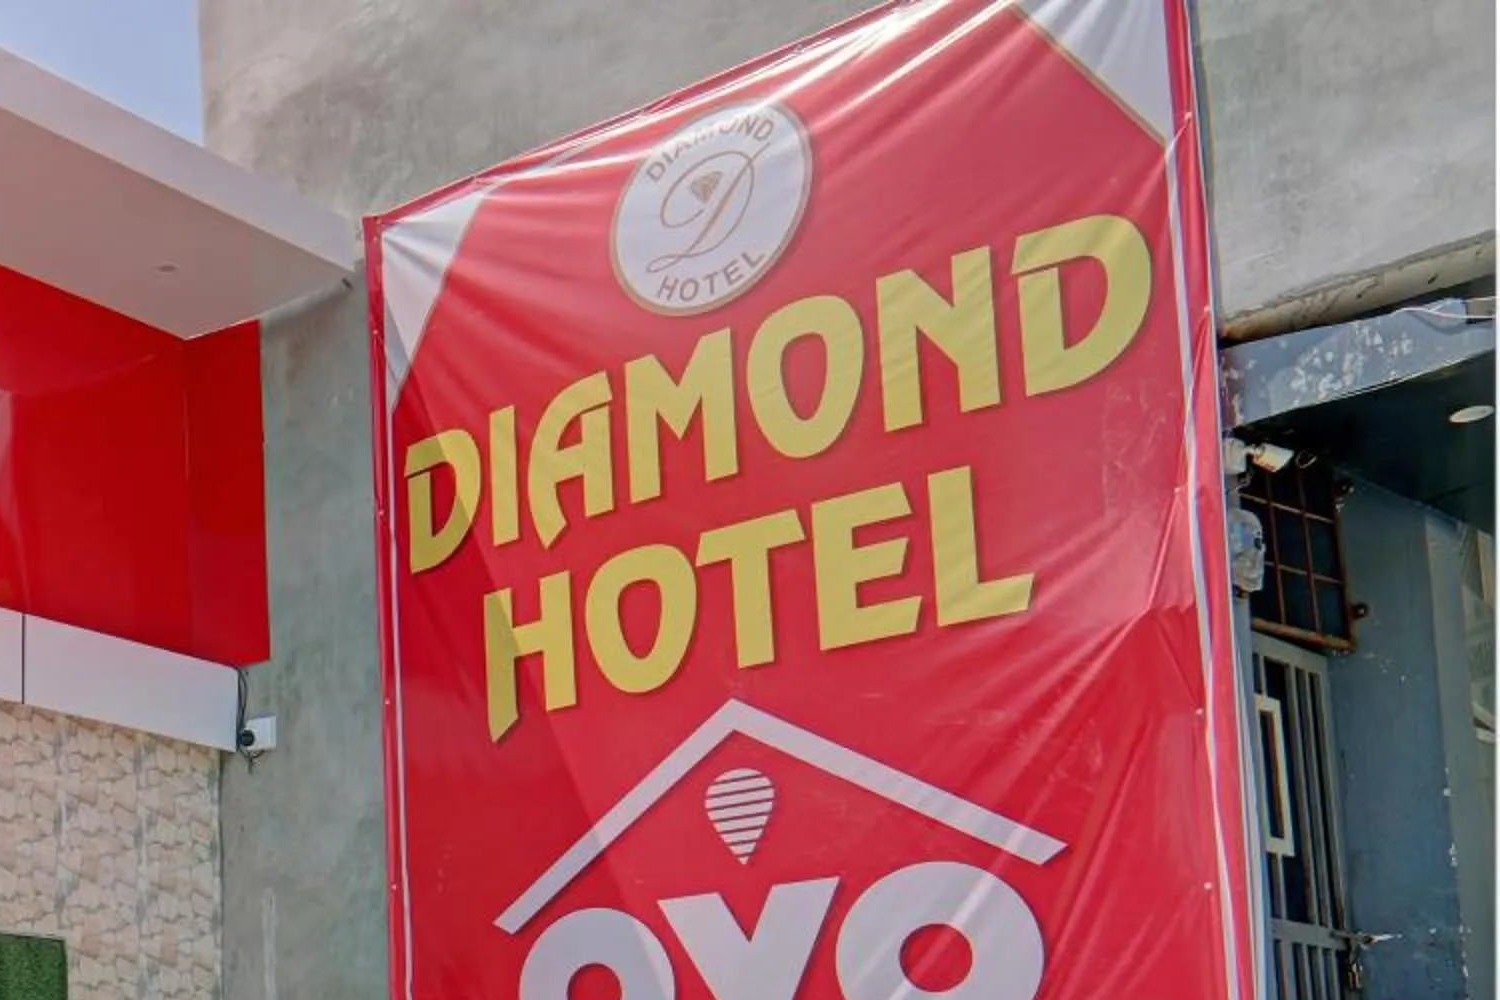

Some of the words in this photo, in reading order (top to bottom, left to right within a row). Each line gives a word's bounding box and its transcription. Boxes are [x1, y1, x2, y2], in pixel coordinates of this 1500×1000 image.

[403, 214, 1152, 575] DIAMOND
[657, 251, 766, 302] HOTEL
[484, 465, 1034, 743] HOTEL
